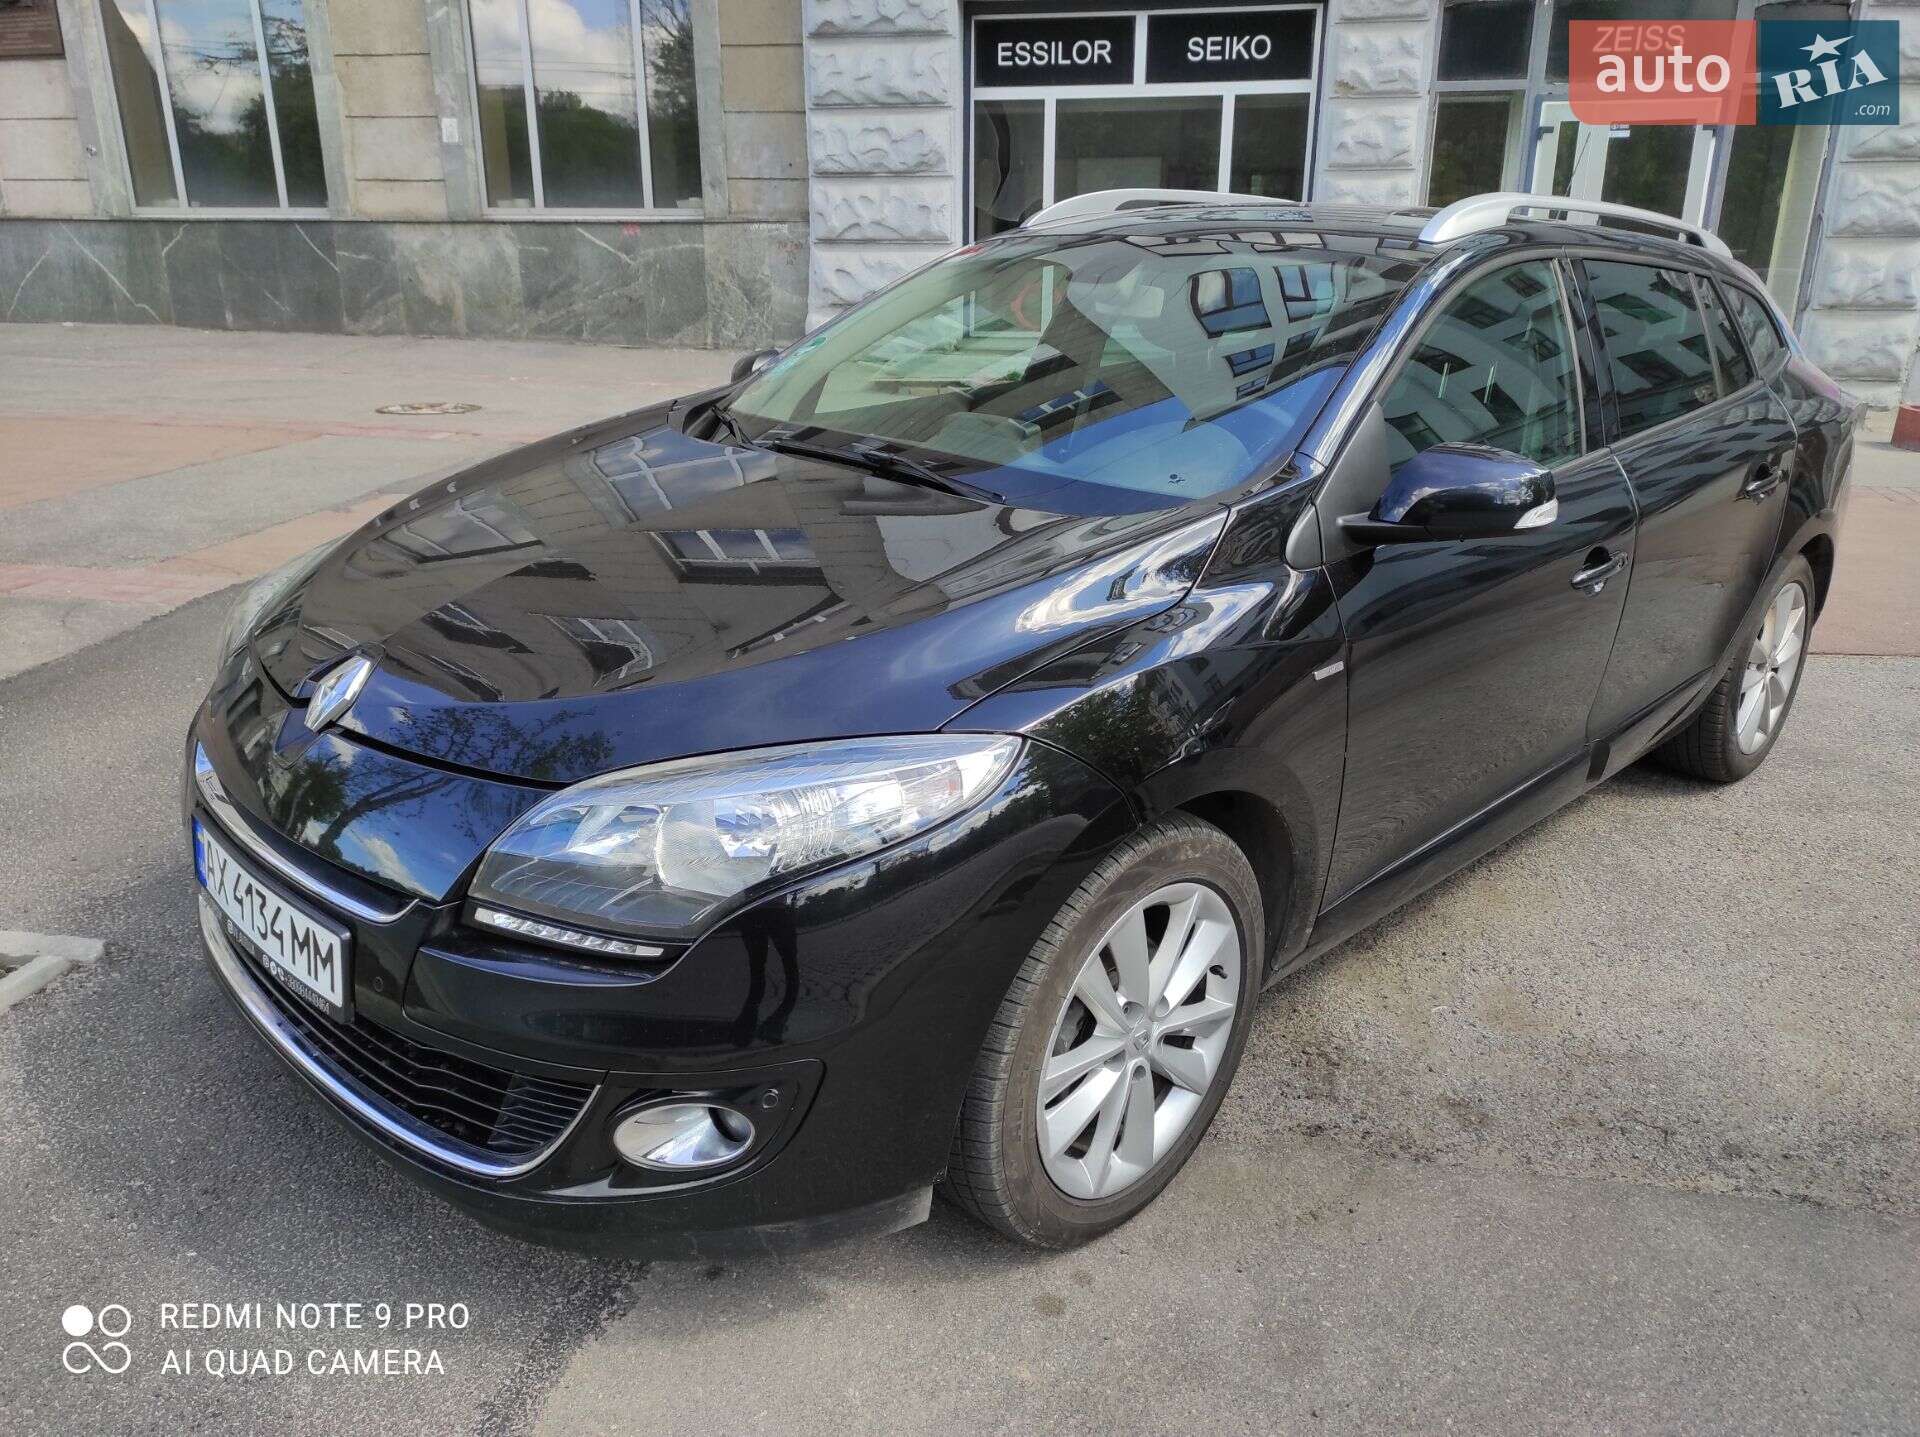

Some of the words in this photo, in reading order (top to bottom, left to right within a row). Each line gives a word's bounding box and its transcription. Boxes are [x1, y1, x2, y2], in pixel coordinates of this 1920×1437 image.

[997, 39, 1113, 67] ESSILOR
[1187, 34, 1272, 63] SEIKO
[1592, 25, 1686, 53] ZEISS
[207, 840, 229, 905] AX
[233, 872, 285, 957] 4134
[290, 914, 336, 993] MM
